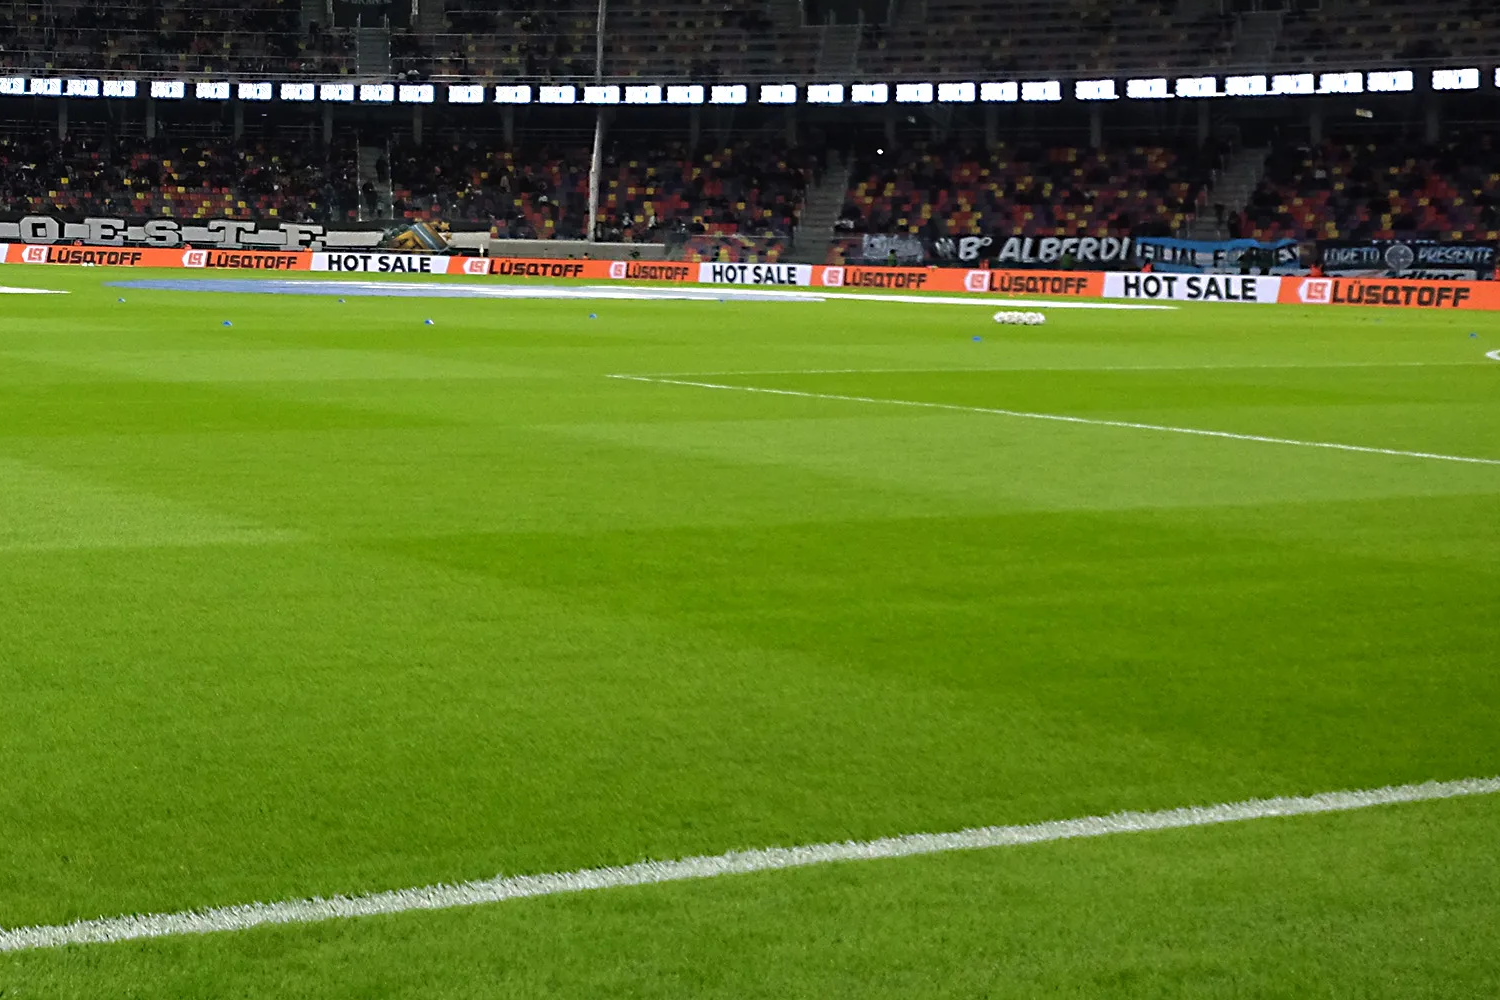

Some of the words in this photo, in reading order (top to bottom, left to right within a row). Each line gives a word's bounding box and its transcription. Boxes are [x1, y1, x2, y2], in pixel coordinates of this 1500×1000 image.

[19, 215, 324, 251] OESTE
[999, 236, 1131, 263] ALBERDI
[328, 254, 371, 272] HOT
[378, 256, 431, 273] SALE
[712, 264, 751, 284] HOT
[753, 266, 797, 285] SALE
[1124, 275, 1177, 298] HOT
[1186, 277, 1257, 300] SALE
